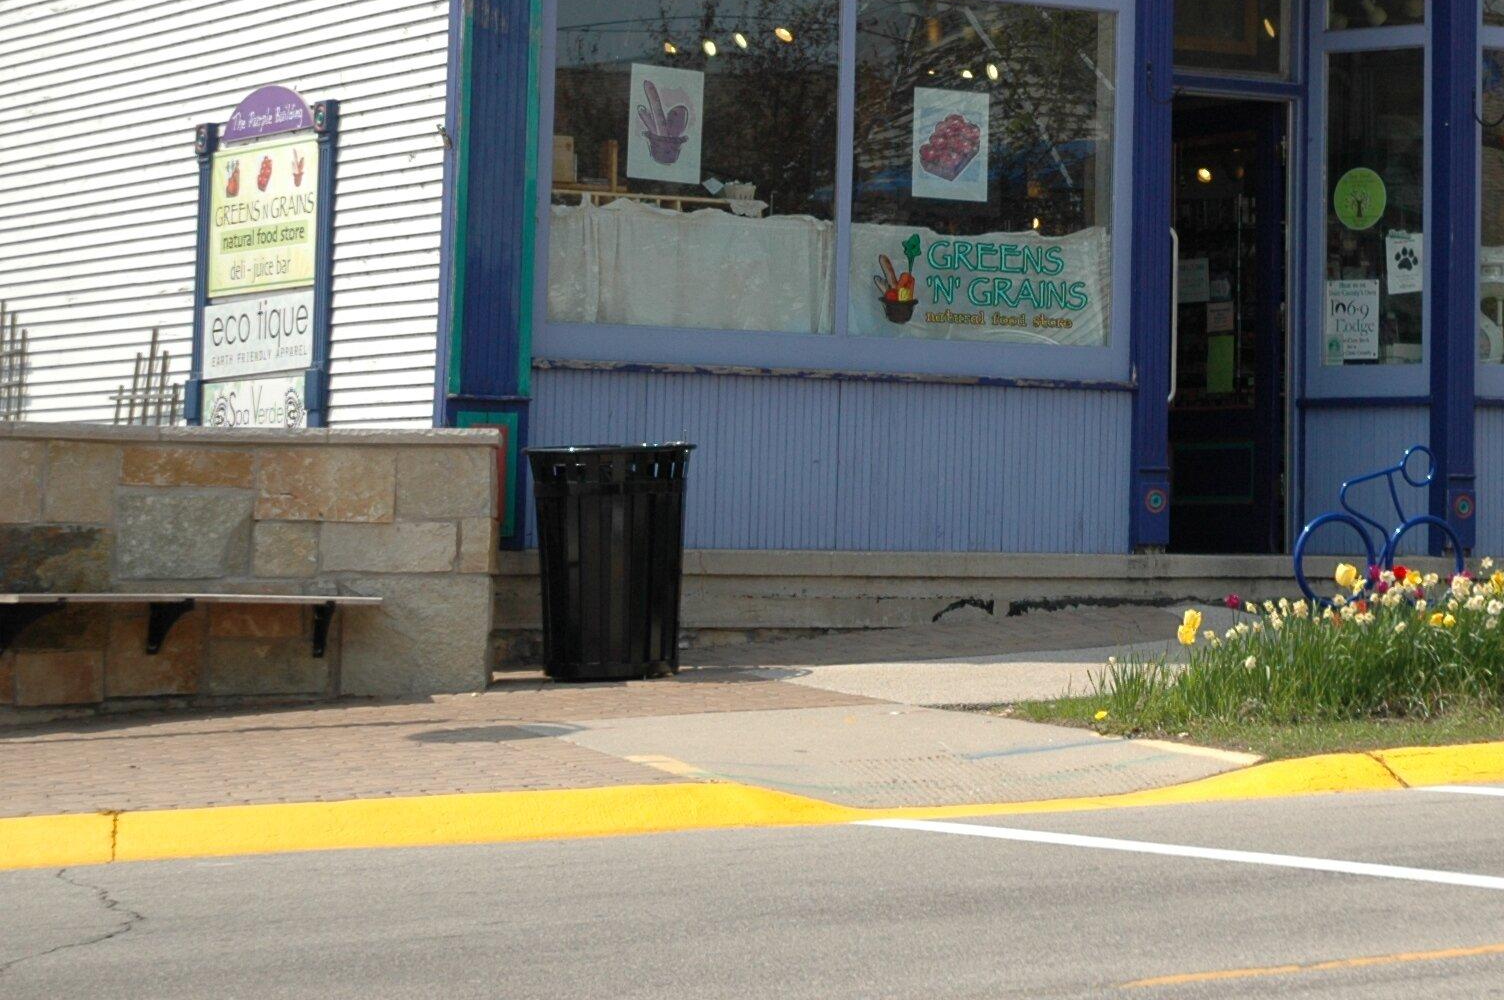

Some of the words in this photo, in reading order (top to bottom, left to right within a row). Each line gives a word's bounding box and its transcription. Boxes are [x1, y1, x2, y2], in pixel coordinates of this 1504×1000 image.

[232, 111, 246, 131] The
[275, 103, 303, 128] Building
[215, 200, 260, 227] GREENS
[263, 204, 269, 220] N
[271, 192, 314, 219] GRAINS
[223, 228, 255, 250] natural
[257, 226, 278, 245] food
[280, 226, 305, 242] store
[230, 260, 245, 280] deli
[252, 257, 273, 283] juice
[276, 255, 291, 275] bar
[927, 240, 1065, 276] GREENS
[926, 275, 961, 305] 'N'
[967, 276, 1089, 311] GRAINS
[212, 313, 251, 346] eco
[257, 299, 309, 354] tique
[925, 308, 985, 326] natural
[991, 311, 1027, 327] food
[1032, 313, 1074, 329] store
[212, 354, 234, 368] EARTH
[237, 350, 272, 364] FRIENDLY
[275, 344, 308, 359] APPAREL
[227, 391, 249, 427] Spa
[251, 385, 284, 425] Verde
